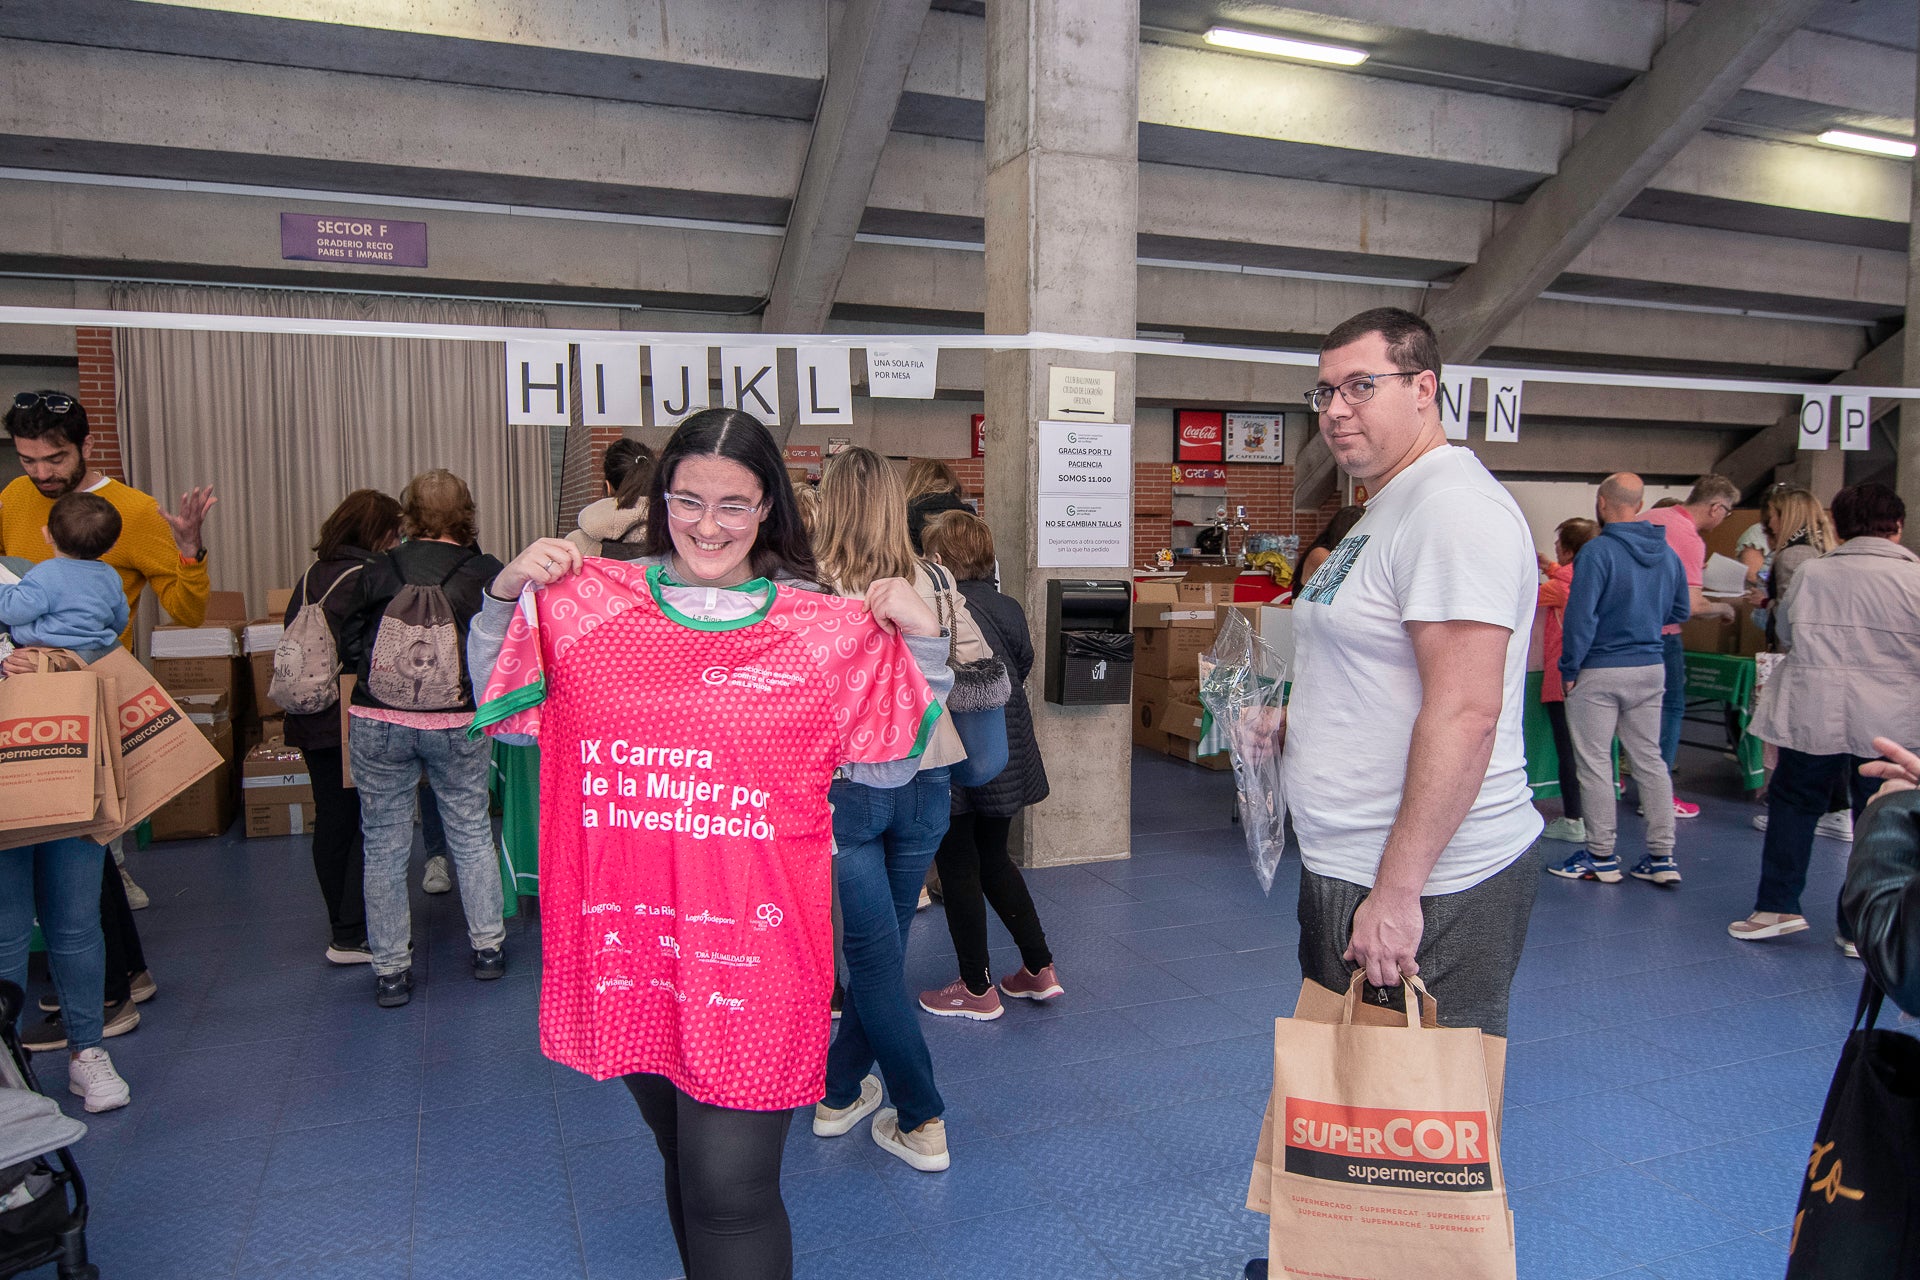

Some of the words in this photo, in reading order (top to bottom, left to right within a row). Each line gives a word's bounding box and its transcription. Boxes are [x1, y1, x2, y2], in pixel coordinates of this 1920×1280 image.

[317, 220, 373, 236] SECTOR
[380, 225, 388, 237] F
[317, 238, 363, 249] GRADERIO
[366, 241, 394, 250] RECTO
[318, 248, 344, 257] PARES
[356, 250, 393, 260] IMPARES
[874, 359, 891, 367] UNA
[892, 360, 910, 368] SOLA
[911, 361, 925, 369] FILA
[875, 371, 890, 379] POR
[891, 372, 911, 380] MESA
[521, 361, 564, 414] H
[595, 363, 606, 414] I
[663, 366, 689, 416] J
[734, 366, 775, 415] K
[808, 366, 840, 414] L
[1440, 382, 1463, 422] N
[1494, 386, 1517, 433] Ñ
[1801, 400, 1824, 435] O
[1846, 409, 1865, 442] P
[1058, 447, 1087, 455] GRACIAS
[1088, 448, 1102, 456] POR
[1058, 474, 1087, 482] SOMOS
[1189, 611, 1198, 619] S
[580, 739, 602, 764] IX
[611, 739, 713, 770] Carrera
[283, 775, 295, 784] M
[582, 771, 609, 796] de
[618, 771, 637, 797] la
[646, 773, 725, 807] Mujer
[731, 785, 771, 811] por
[582, 802, 599, 828] la
[609, 802, 776, 841] Investigación
[711, 951, 746, 963] HUMILDAD
[1292, 1117, 1482, 1160] SUPERCOR
[1348, 1164, 1485, 1186] supermercados
[1291, 1195, 1353, 1210] SUPERMERCADO
[1359, 1205, 1419, 1217] SUPERMERCAT
[1298, 1207, 1353, 1222] SUPERMARKET
[1429, 1223, 1485, 1233] SUPERMARKT
